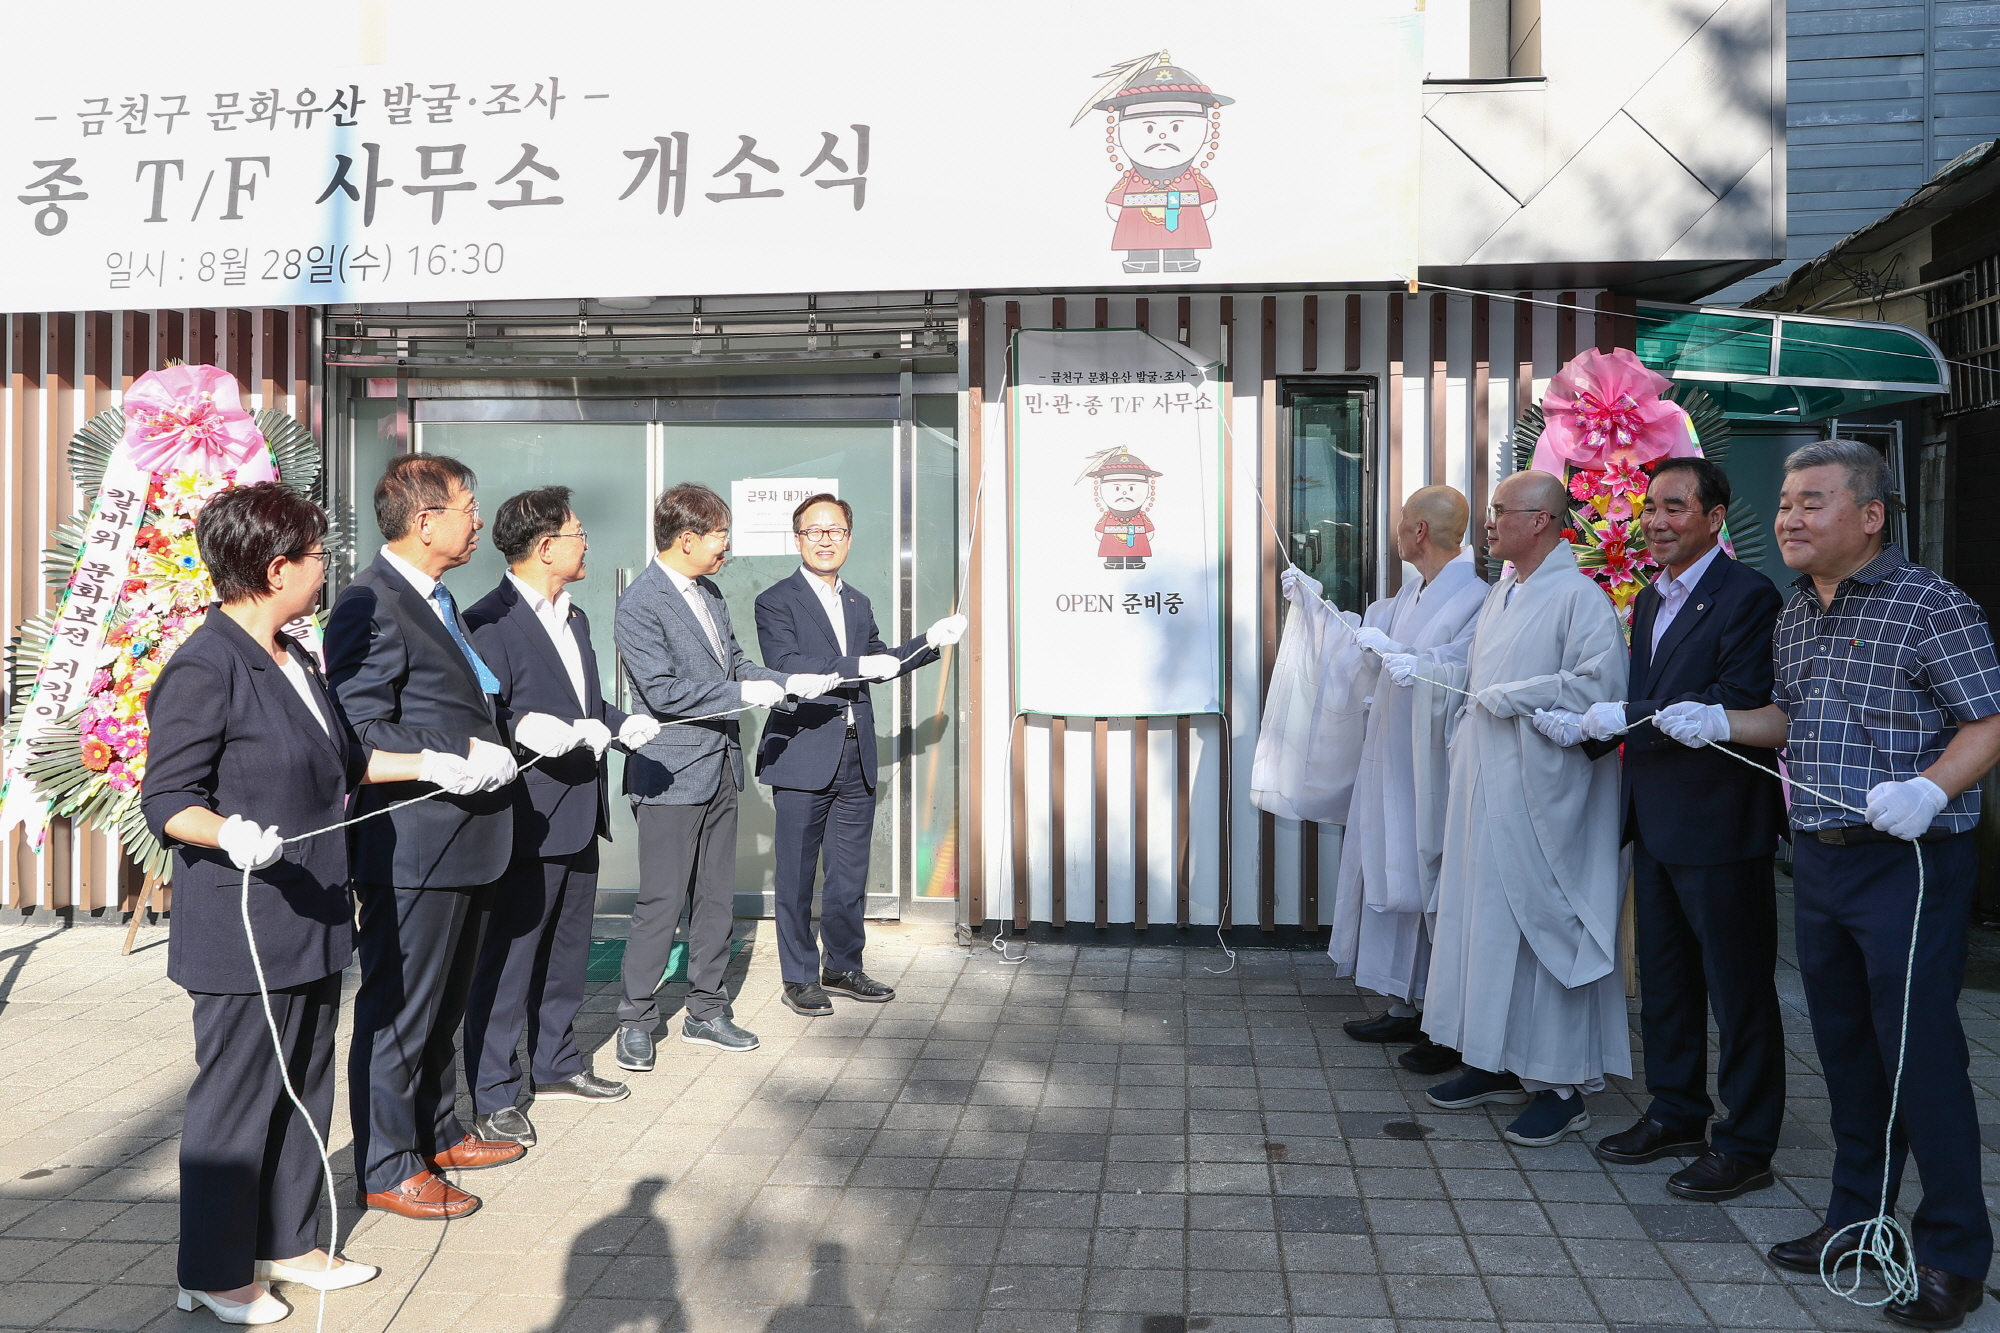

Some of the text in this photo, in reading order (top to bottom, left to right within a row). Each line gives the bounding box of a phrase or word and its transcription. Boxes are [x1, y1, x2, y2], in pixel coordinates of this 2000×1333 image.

[76, 94, 191, 138] 금천구
[206, 84, 367, 132] 문화유산
[382, 76, 566, 125] 발굴·조사
[16, 123, 871, 237] 종 T/F 사무소 개소식
[197, 247, 249, 286] 8월
[261, 243, 392, 286] 28일(수)
[408, 242, 504, 276] 16:30
[1050, 371, 1084, 384] 금천구
[1087, 371, 1133, 384] 문화유산
[1136, 370, 1187, 383] 발굴·조사
[1110, 396, 1145, 414] T/F
[1152, 391, 1213, 415] 사무소
[747, 490, 778, 503] 근무자
[58, 561, 116, 647] 문화보전
[1055, 591, 1185, 616] OPEN 준비중
